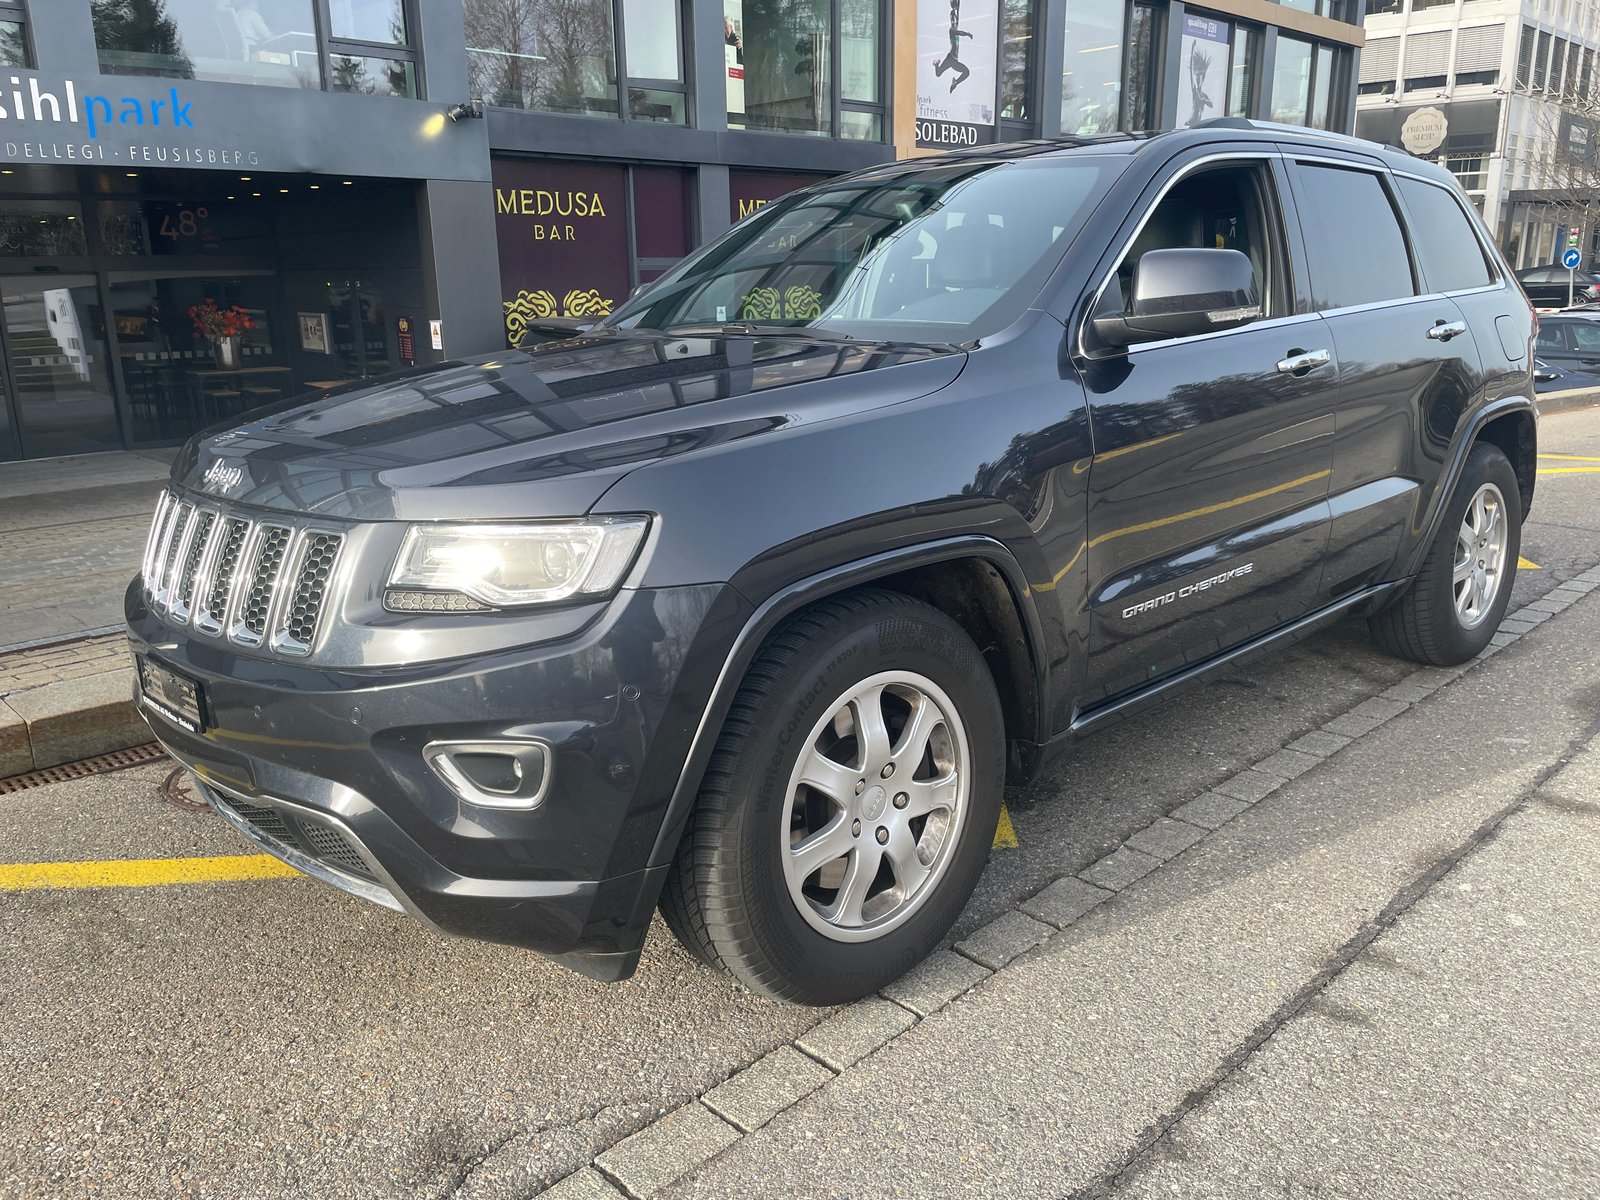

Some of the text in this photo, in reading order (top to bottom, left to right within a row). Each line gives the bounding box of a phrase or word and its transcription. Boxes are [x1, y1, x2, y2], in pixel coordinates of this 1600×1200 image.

[915, 121, 978, 145] SOLEBAD
[1406, 124, 1443, 134] PREMIUM
[129, 145, 258, 166] FEUSISBERG
[496, 188, 607, 217] MEDUSA
[534, 224, 576, 241] BAR
[1122, 563, 1253, 619] GRAND CHEROKEE
